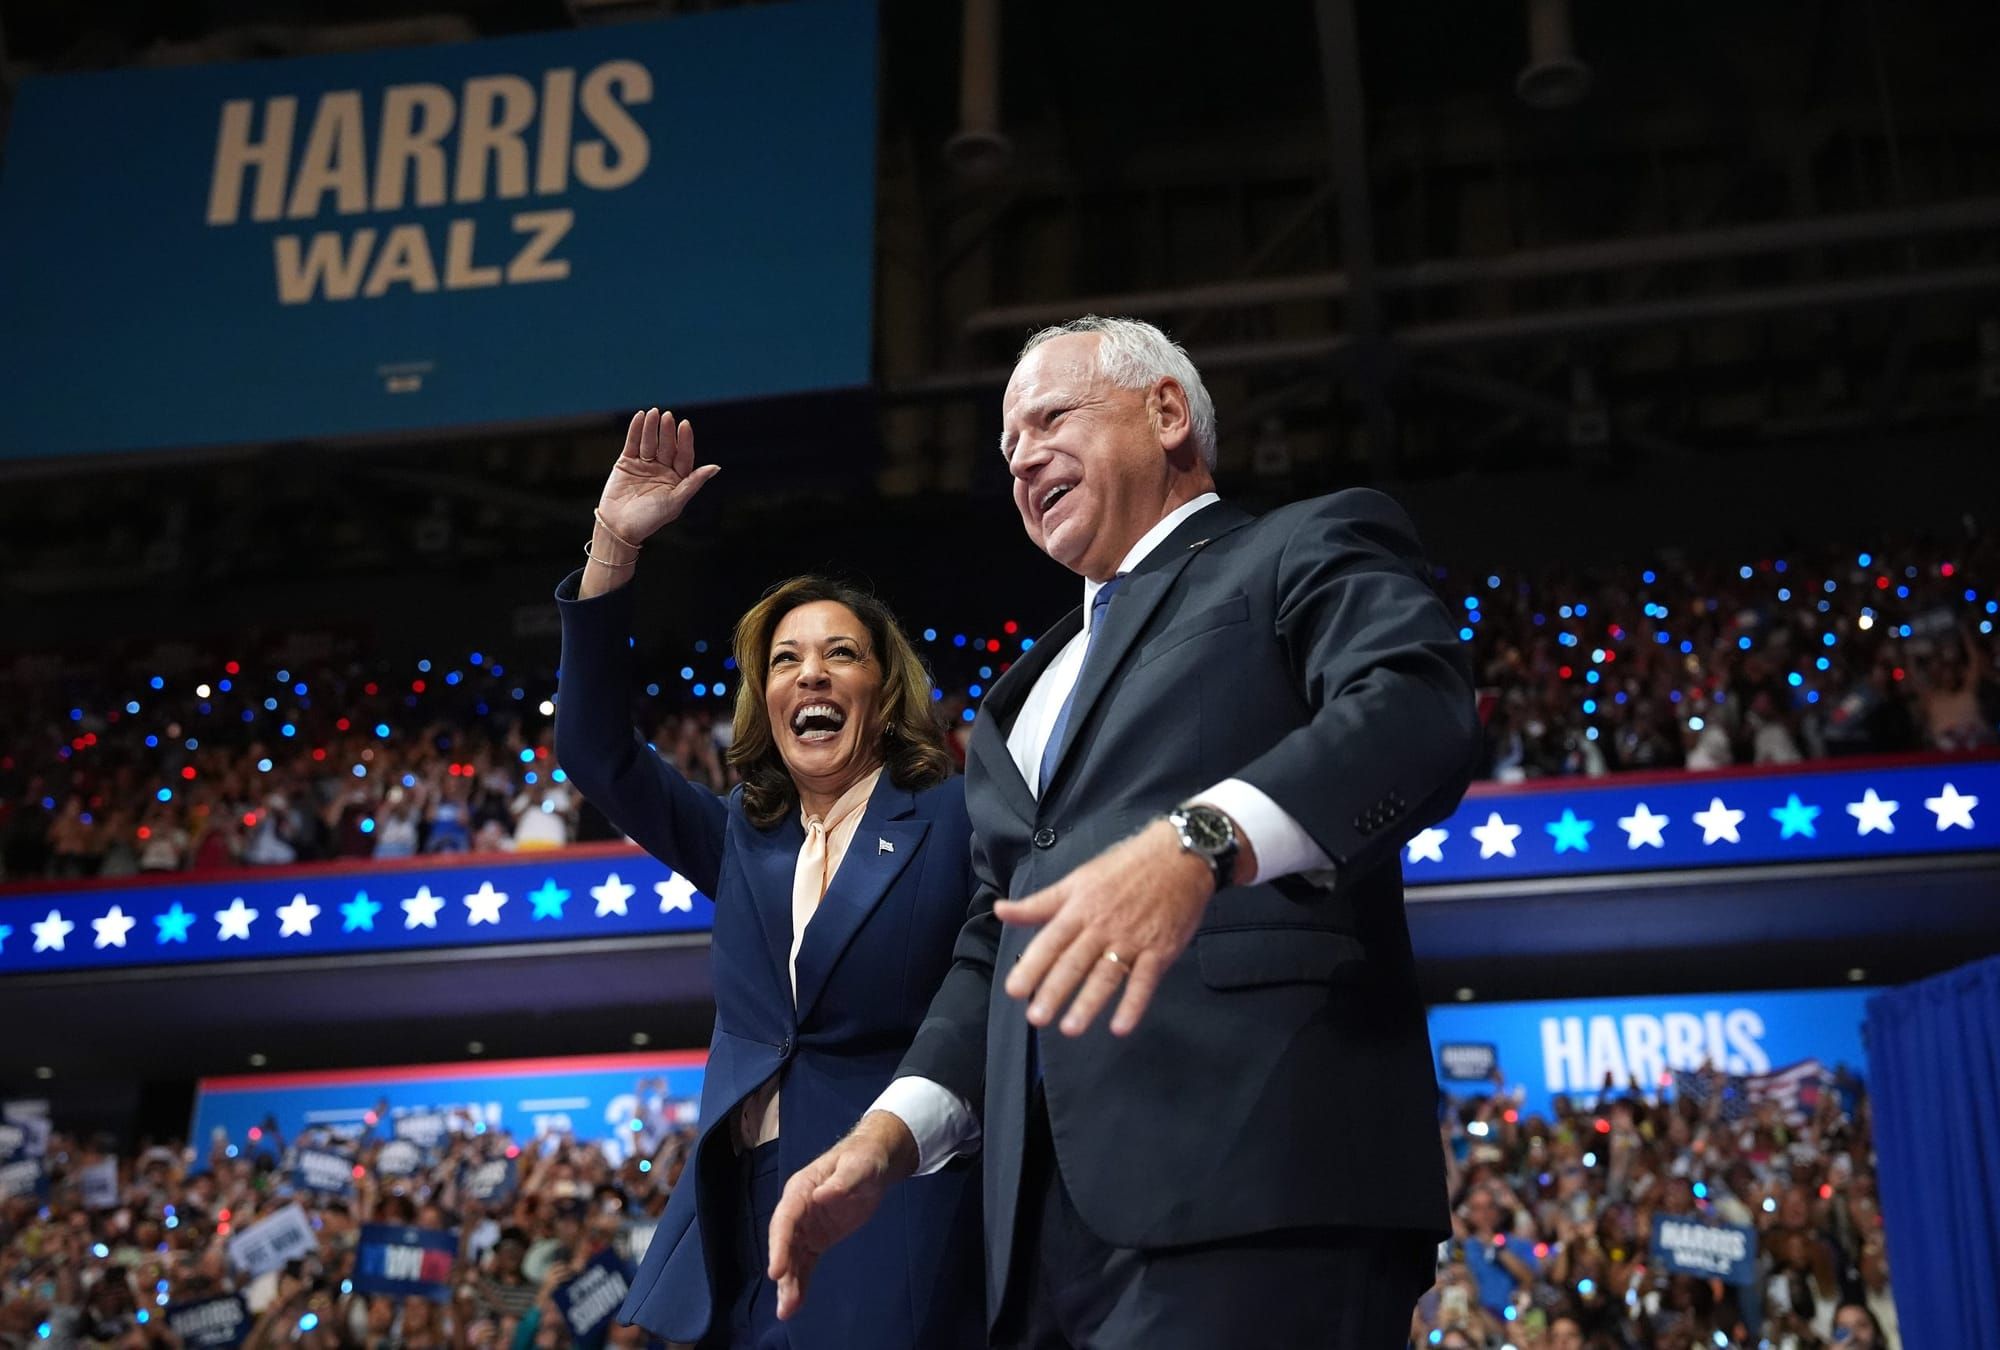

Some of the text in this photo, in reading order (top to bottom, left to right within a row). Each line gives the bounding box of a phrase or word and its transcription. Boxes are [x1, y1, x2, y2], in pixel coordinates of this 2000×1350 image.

[206, 60, 655, 226] HARRIS
[274, 209, 575, 305] WALZ
[1541, 1008, 1771, 1092] HARRIS
